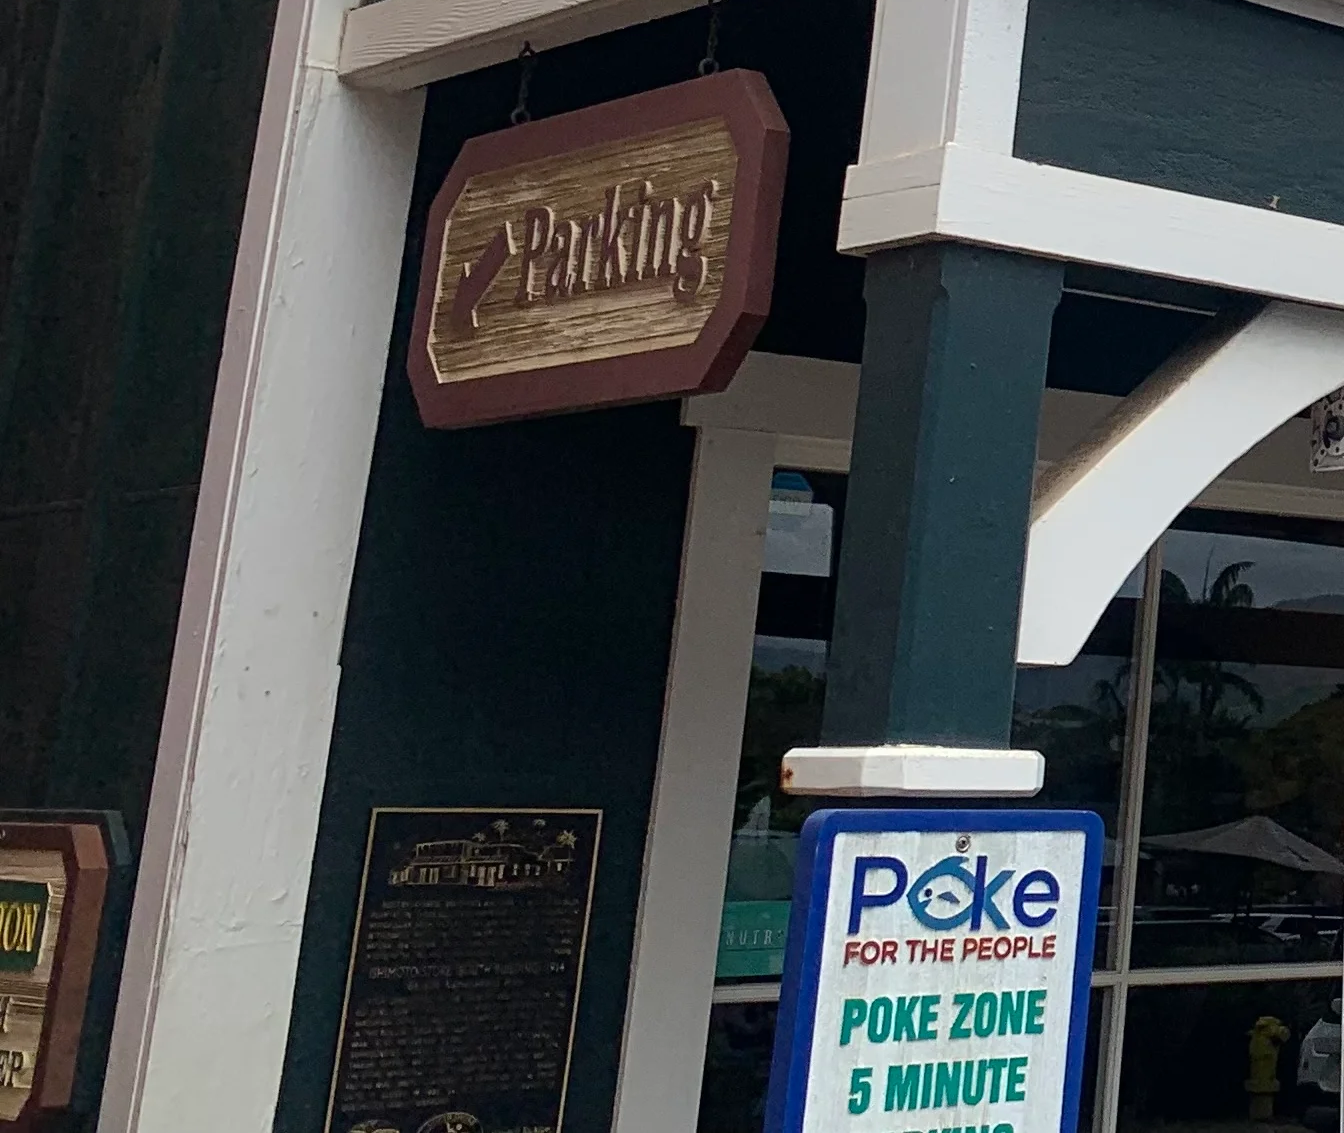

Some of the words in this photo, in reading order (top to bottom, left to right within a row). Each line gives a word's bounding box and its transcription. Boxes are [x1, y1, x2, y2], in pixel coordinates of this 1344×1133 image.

[516, 179, 719, 304] Parking
[847, 855, 1061, 936] Poke
[843, 939, 899, 968] FOR
[905, 937, 957, 964] THE
[961, 934, 1057, 963] PEOPLE
[839, 993, 942, 1047] POKE
[949, 988, 1048, 1040] ZONE
[848, 1067, 873, 1115] 5
[884, 1056, 1029, 1112] MINUTE
